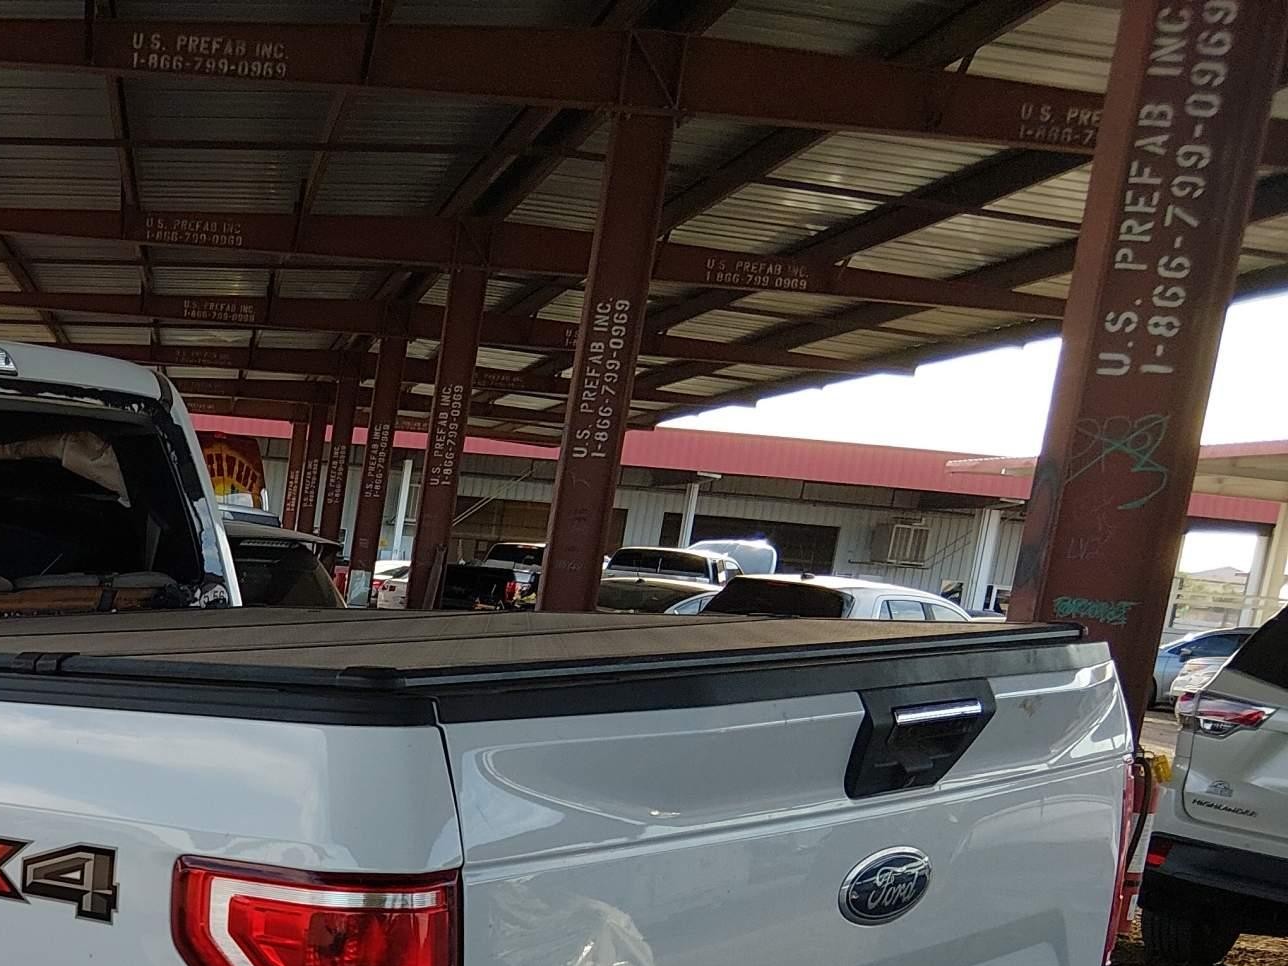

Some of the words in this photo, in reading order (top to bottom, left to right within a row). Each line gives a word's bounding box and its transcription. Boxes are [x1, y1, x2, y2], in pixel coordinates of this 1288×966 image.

[132, 32, 166, 50] US.
[176, 35, 246, 56] PREFAB
[255, 42, 289, 59] INC.
[132, 52, 287, 78] 1-866-799-0969
[1066, 108, 1104, 127] PRE
[1114, 104, 1174, 270] PREFAB
[1139, 1, 1239, 374] 1-866-799-0969
[736, 261, 782, 275] PREFAB
[593, 297, 613, 332] INC.
[1096, 299, 1141, 376] U.S.
[440, 384, 453, 406] INC.
[580, 342, 605, 413] PREFAB
[591, 299, 630, 457] 1-866-799-0969
[434, 412, 449, 457] PREFAB
[441, 385, 464, 485] 1-866-799-0969
[572, 424, 593, 458] U.S.
[430, 463, 442, 486] U.S.
